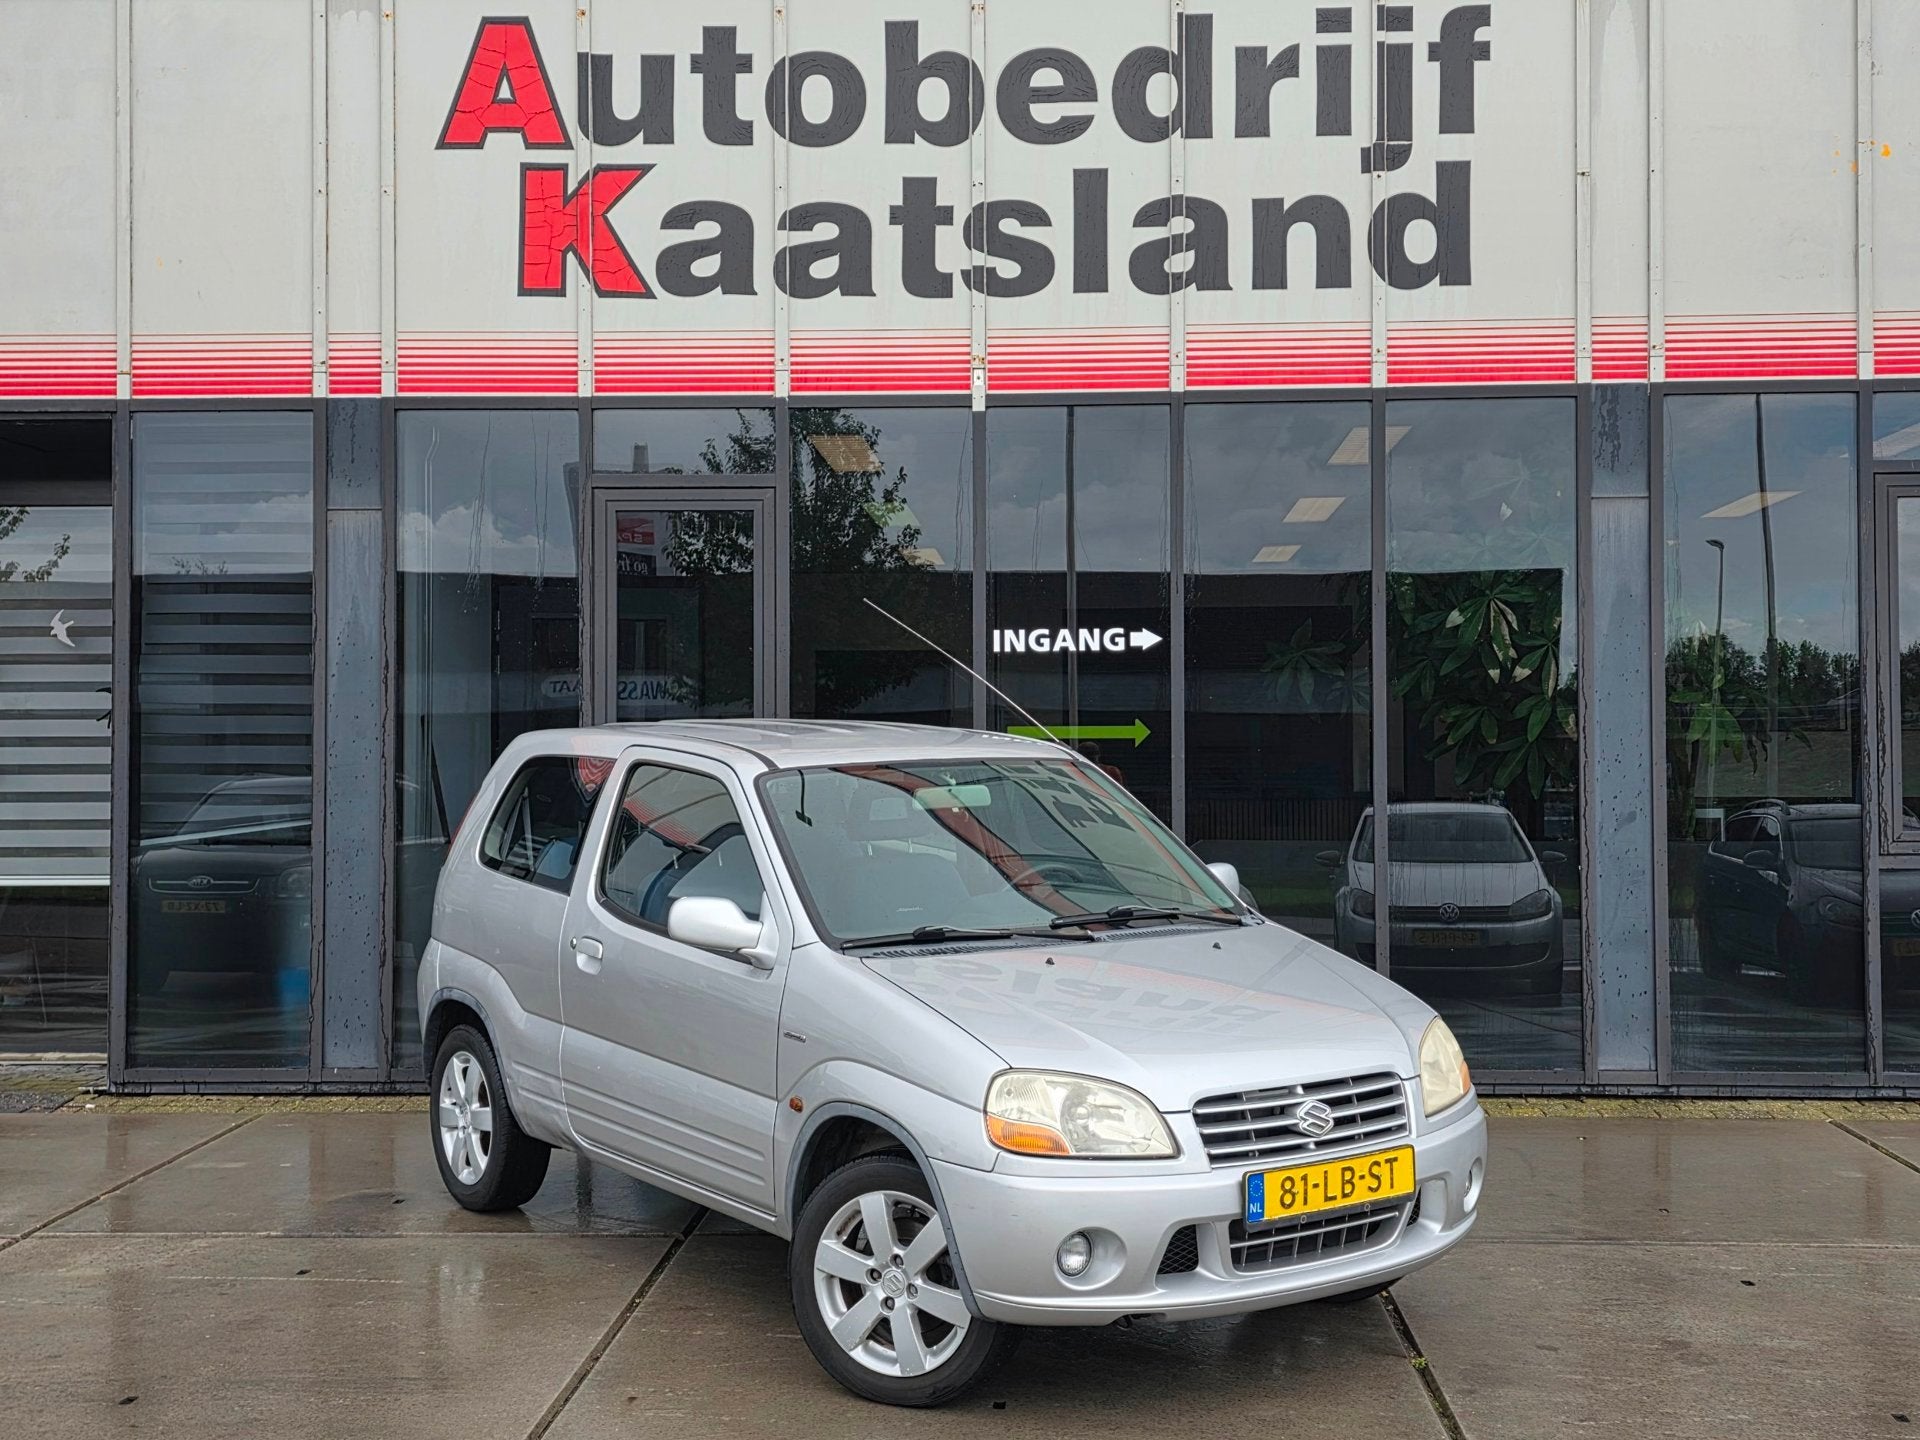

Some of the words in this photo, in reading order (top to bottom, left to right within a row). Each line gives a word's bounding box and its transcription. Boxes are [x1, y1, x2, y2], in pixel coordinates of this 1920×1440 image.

[434, 5, 1492, 174] Autobedrijf
[517, 160, 1472, 299] Kaatsland
[993, 627, 1126, 653] INGANG
[1249, 1203, 1263, 1214] NL
[1279, 1156, 1399, 1210] 81-LB-ST
